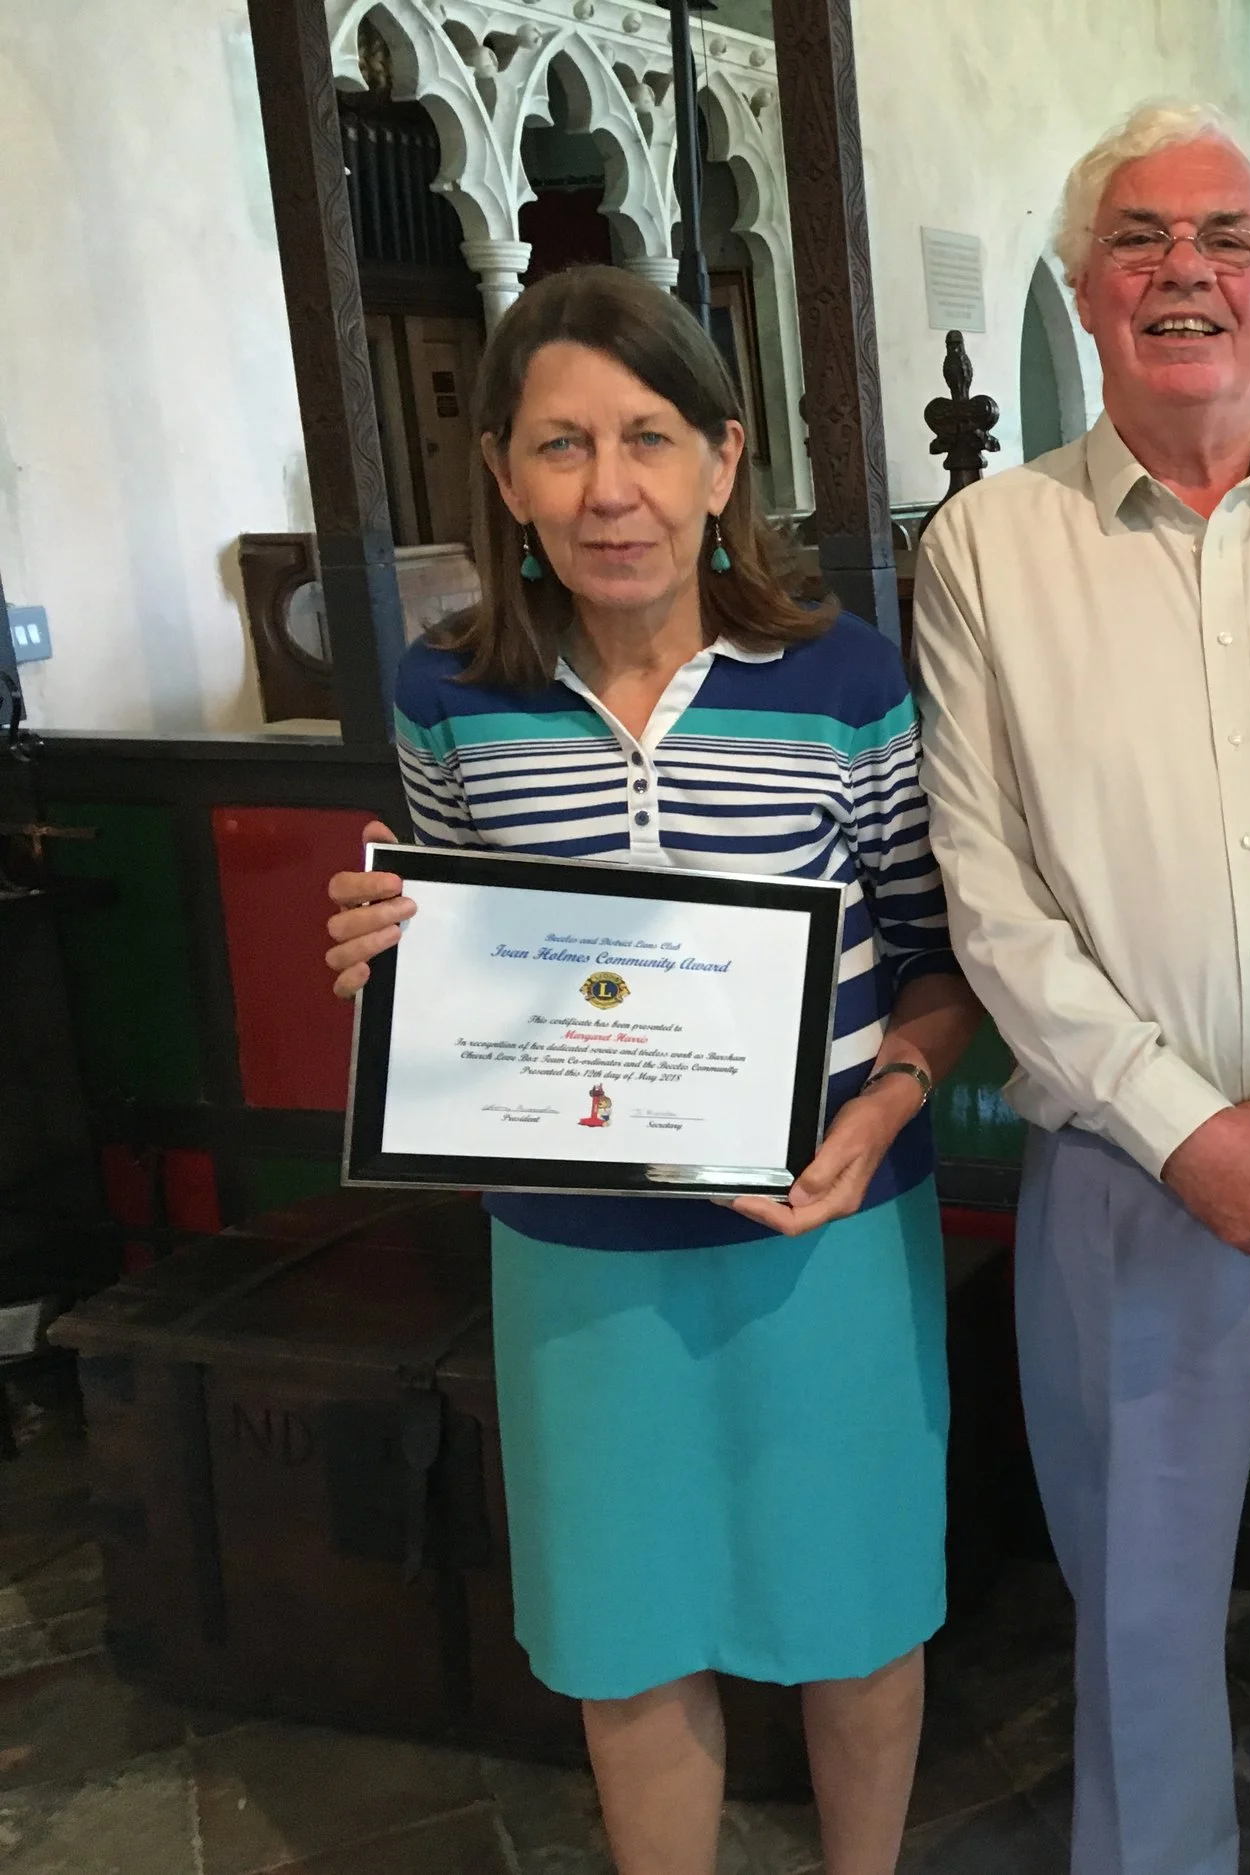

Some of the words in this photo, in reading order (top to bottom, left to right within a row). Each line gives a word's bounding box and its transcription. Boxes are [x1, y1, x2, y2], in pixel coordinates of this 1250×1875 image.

[579, 936, 598, 946] and
[490, 943, 530, 960] Ivan
[532, 946, 591, 964] Holmes
[595, 951, 677, 974] Community
[679, 957, 734, 974] Award
[597, 982, 613, 998] L
[527, 1014, 548, 1025] This
[549, 1016, 593, 1028] certificate
[593, 1018, 609, 1028] has
[611, 1020, 631, 1030] been
[631, 1022, 674, 1032] presented
[674, 1024, 683, 1032] to
[560, 1029, 612, 1042] Margaret
[614, 1032, 649, 1044] Harris
[454, 1037, 467, 1047] In
[469, 1039, 517, 1050] recognition
[518, 1041, 530, 1052] of
[530, 1041, 545, 1051] her
[547, 1043, 589, 1053] dedicated
[591, 1046, 618, 1055] service
[619, 1048, 638, 1057] and
[638, 1048, 669, 1058] tireless
[671, 1051, 693, 1060] work
[706, 1051, 746, 1062] Barsham
[460, 1050, 493, 1061] Church
[518, 1053, 539, 1063] Box
[541, 1054, 565, 1064] Team
[567, 1056, 622, 1068] Co-ordinator
[623, 1059, 641, 1068] and
[642, 1060, 656, 1069] the
[656, 1061, 689, 1071] Beccles
[691, 1064, 738, 1075] Community
[519, 1065, 564, 1077] Presented
[565, 1068, 581, 1077] this
[583, 1069, 602, 1078] 12th
[603, 1071, 621, 1081] day
[623, 1071, 635, 1082] of
[635, 1072, 657, 1083] May
[659, 1073, 683, 1082] 2018
[500, 1113, 541, 1123] President
